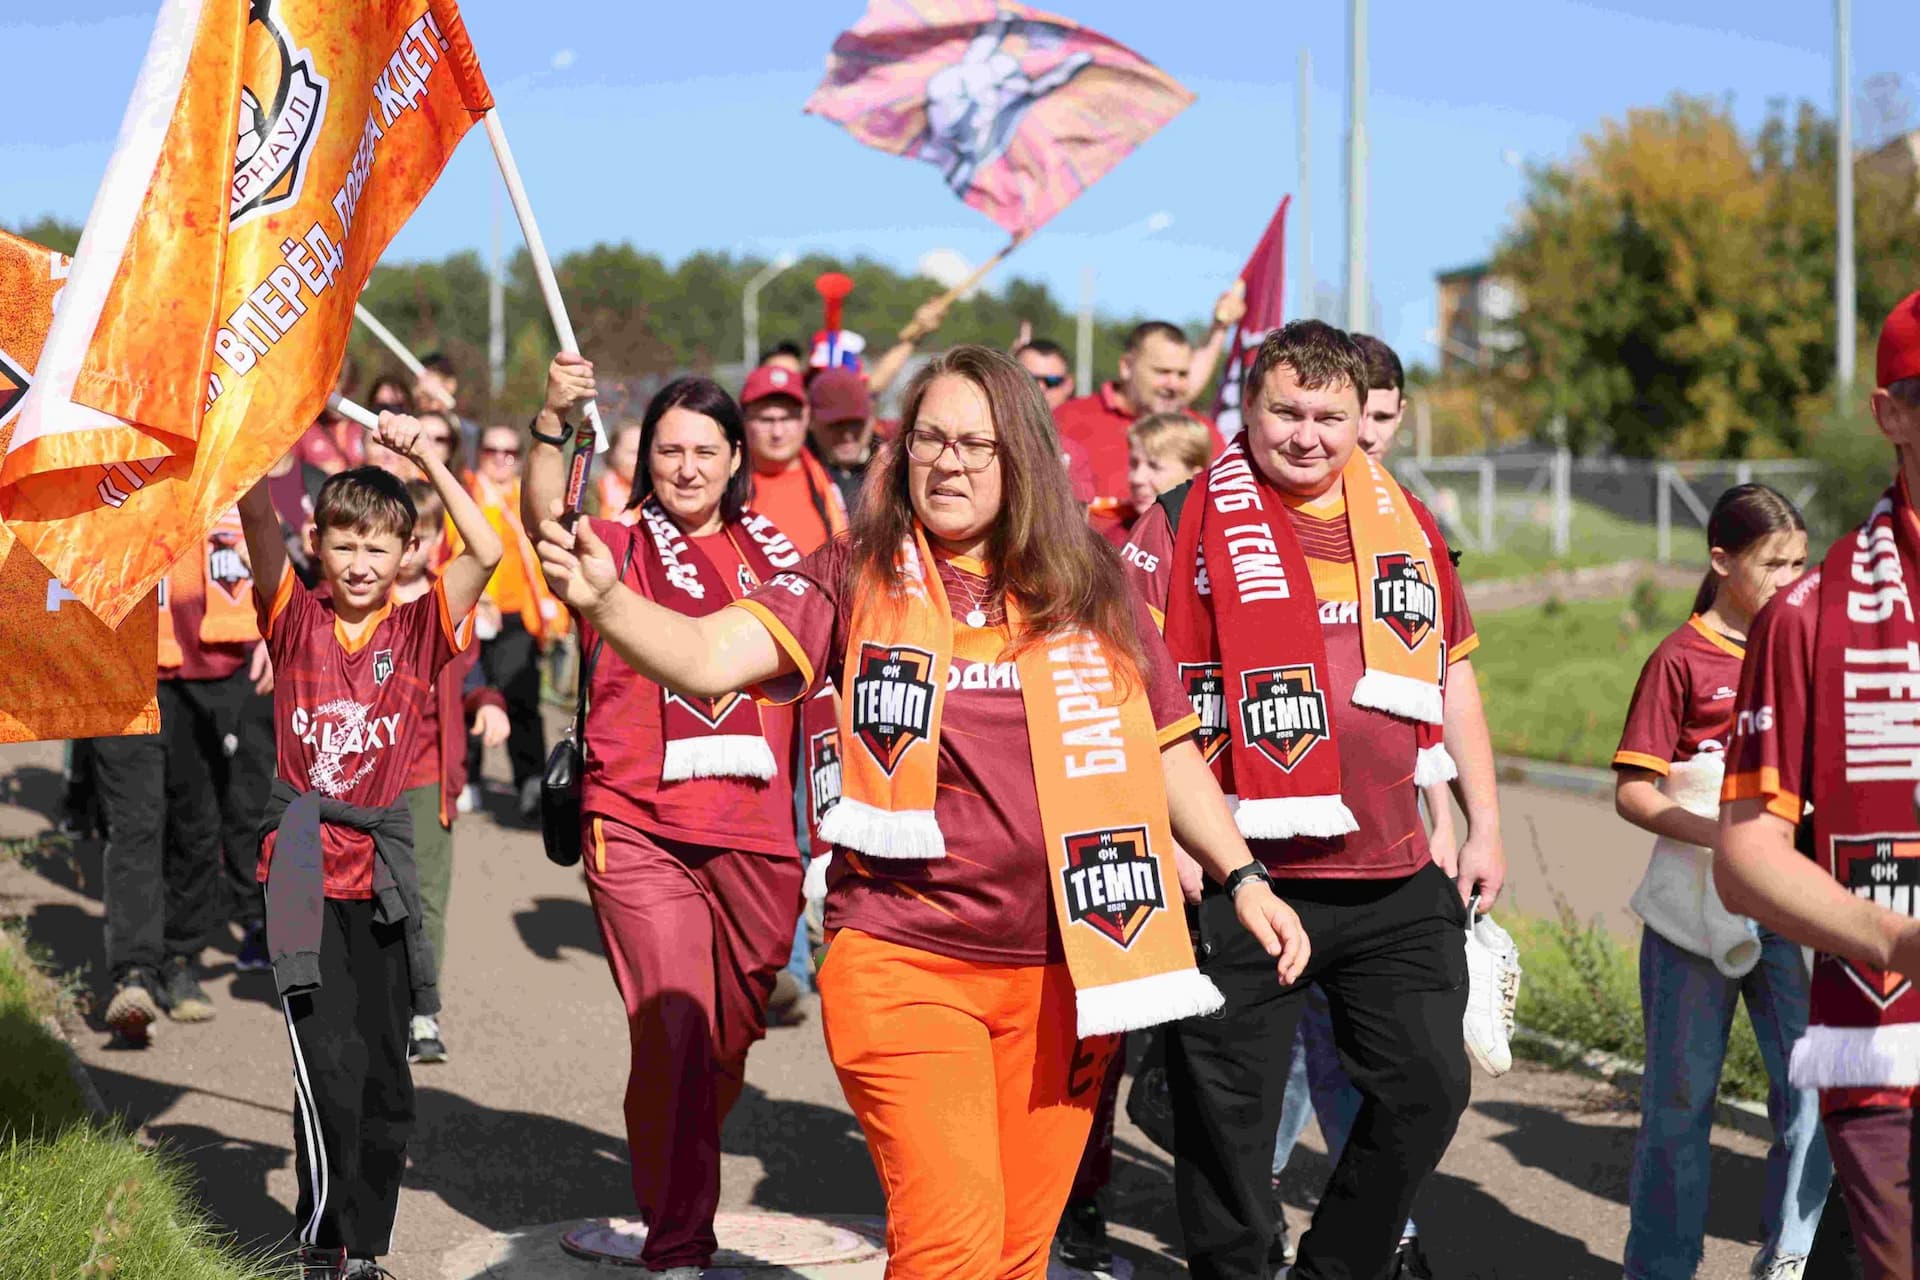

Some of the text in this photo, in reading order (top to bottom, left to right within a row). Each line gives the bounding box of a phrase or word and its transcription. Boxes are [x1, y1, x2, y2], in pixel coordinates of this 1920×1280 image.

[231, 96, 310, 204] РНАУЛ
[214, 8, 451, 378] ВПЕРЁД, ПОБЕДА ЖДЕТ!
[1121, 542, 1160, 573] ПСБ
[1223, 522, 1290, 604] ТЕМП
[1377, 579, 1434, 615] ТЕМП
[881, 664, 901, 679] ФК
[1270, 683, 1289, 695] ФК
[856, 679, 928, 731] ТЕМП
[1247, 696, 1321, 737] ТЕМП
[1844, 640, 1920, 783] ТЕМП
[1097, 846, 1119, 861] ФК
[1870, 862, 1898, 883] ФК
[1070, 861, 1156, 912] ТЕМП
[1106, 902, 1127, 913] 2020
